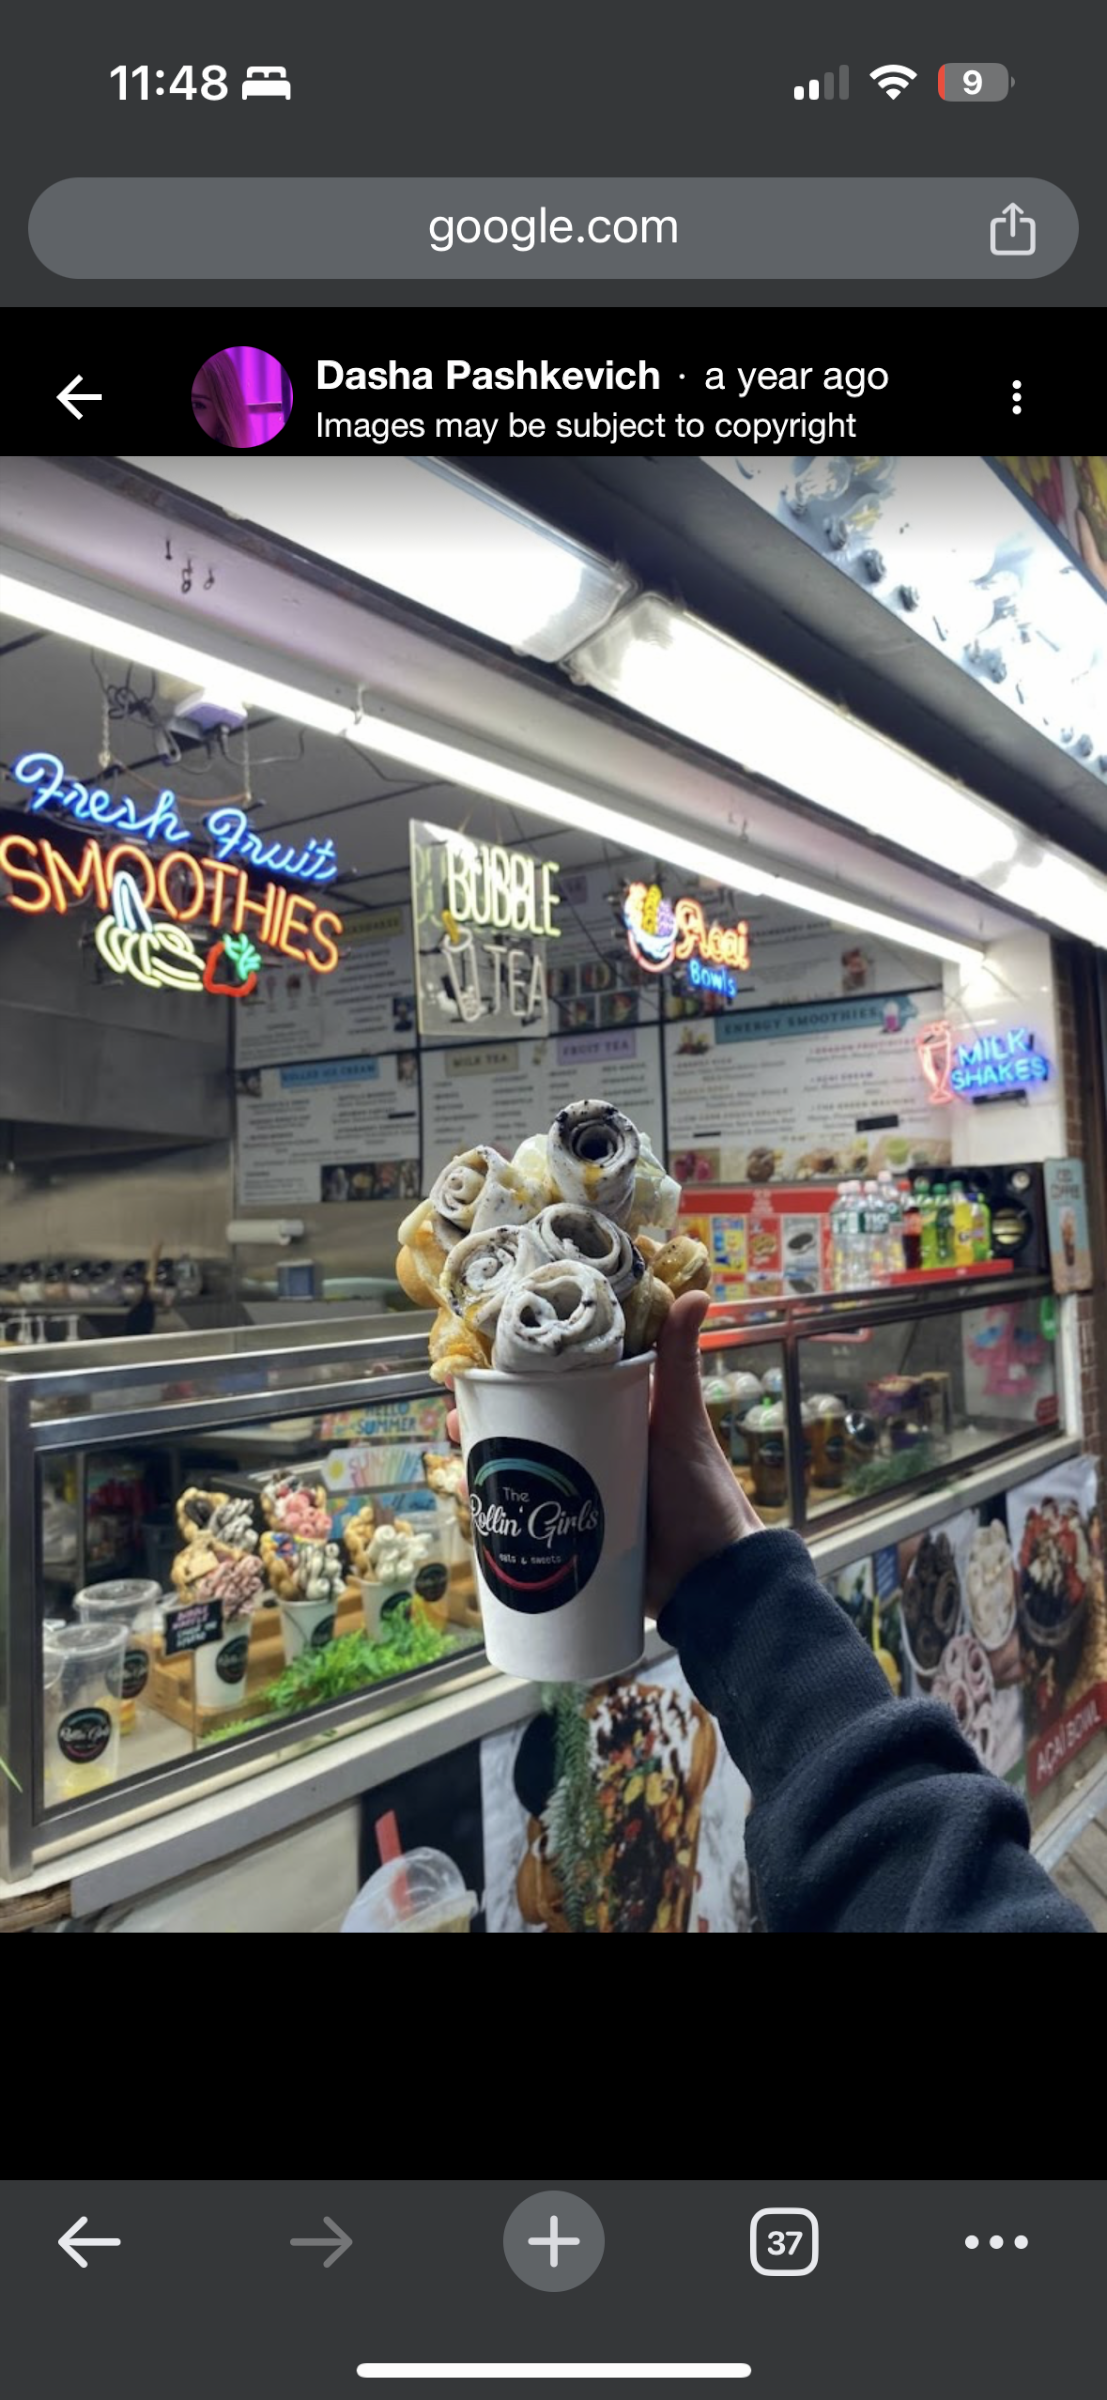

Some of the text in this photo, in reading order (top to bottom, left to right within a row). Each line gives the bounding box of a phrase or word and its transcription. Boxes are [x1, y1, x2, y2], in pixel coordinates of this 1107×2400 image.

[14, 752, 337, 881] Fresh Fruit
[0, 835, 344, 974] SMOOTHIES
[446, 846, 561, 937] BUBBLE
[482, 943, 549, 1016] TEA
[688, 959, 738, 997] Bowls
[723, 1008, 878, 1036] ENERGY SMOOTHIES
[452, 1053, 508, 1068] MILK TEA
[561, 1038, 630, 1057] FRUIT TEA
[957, 1028, 1029, 1067] MILK
[951, 1056, 1047, 1092] SHAKES
[357, 1416, 417, 1436] SUMMER
[502, 1486, 531, 1503] The
[527, 1499, 600, 1549] Girls
